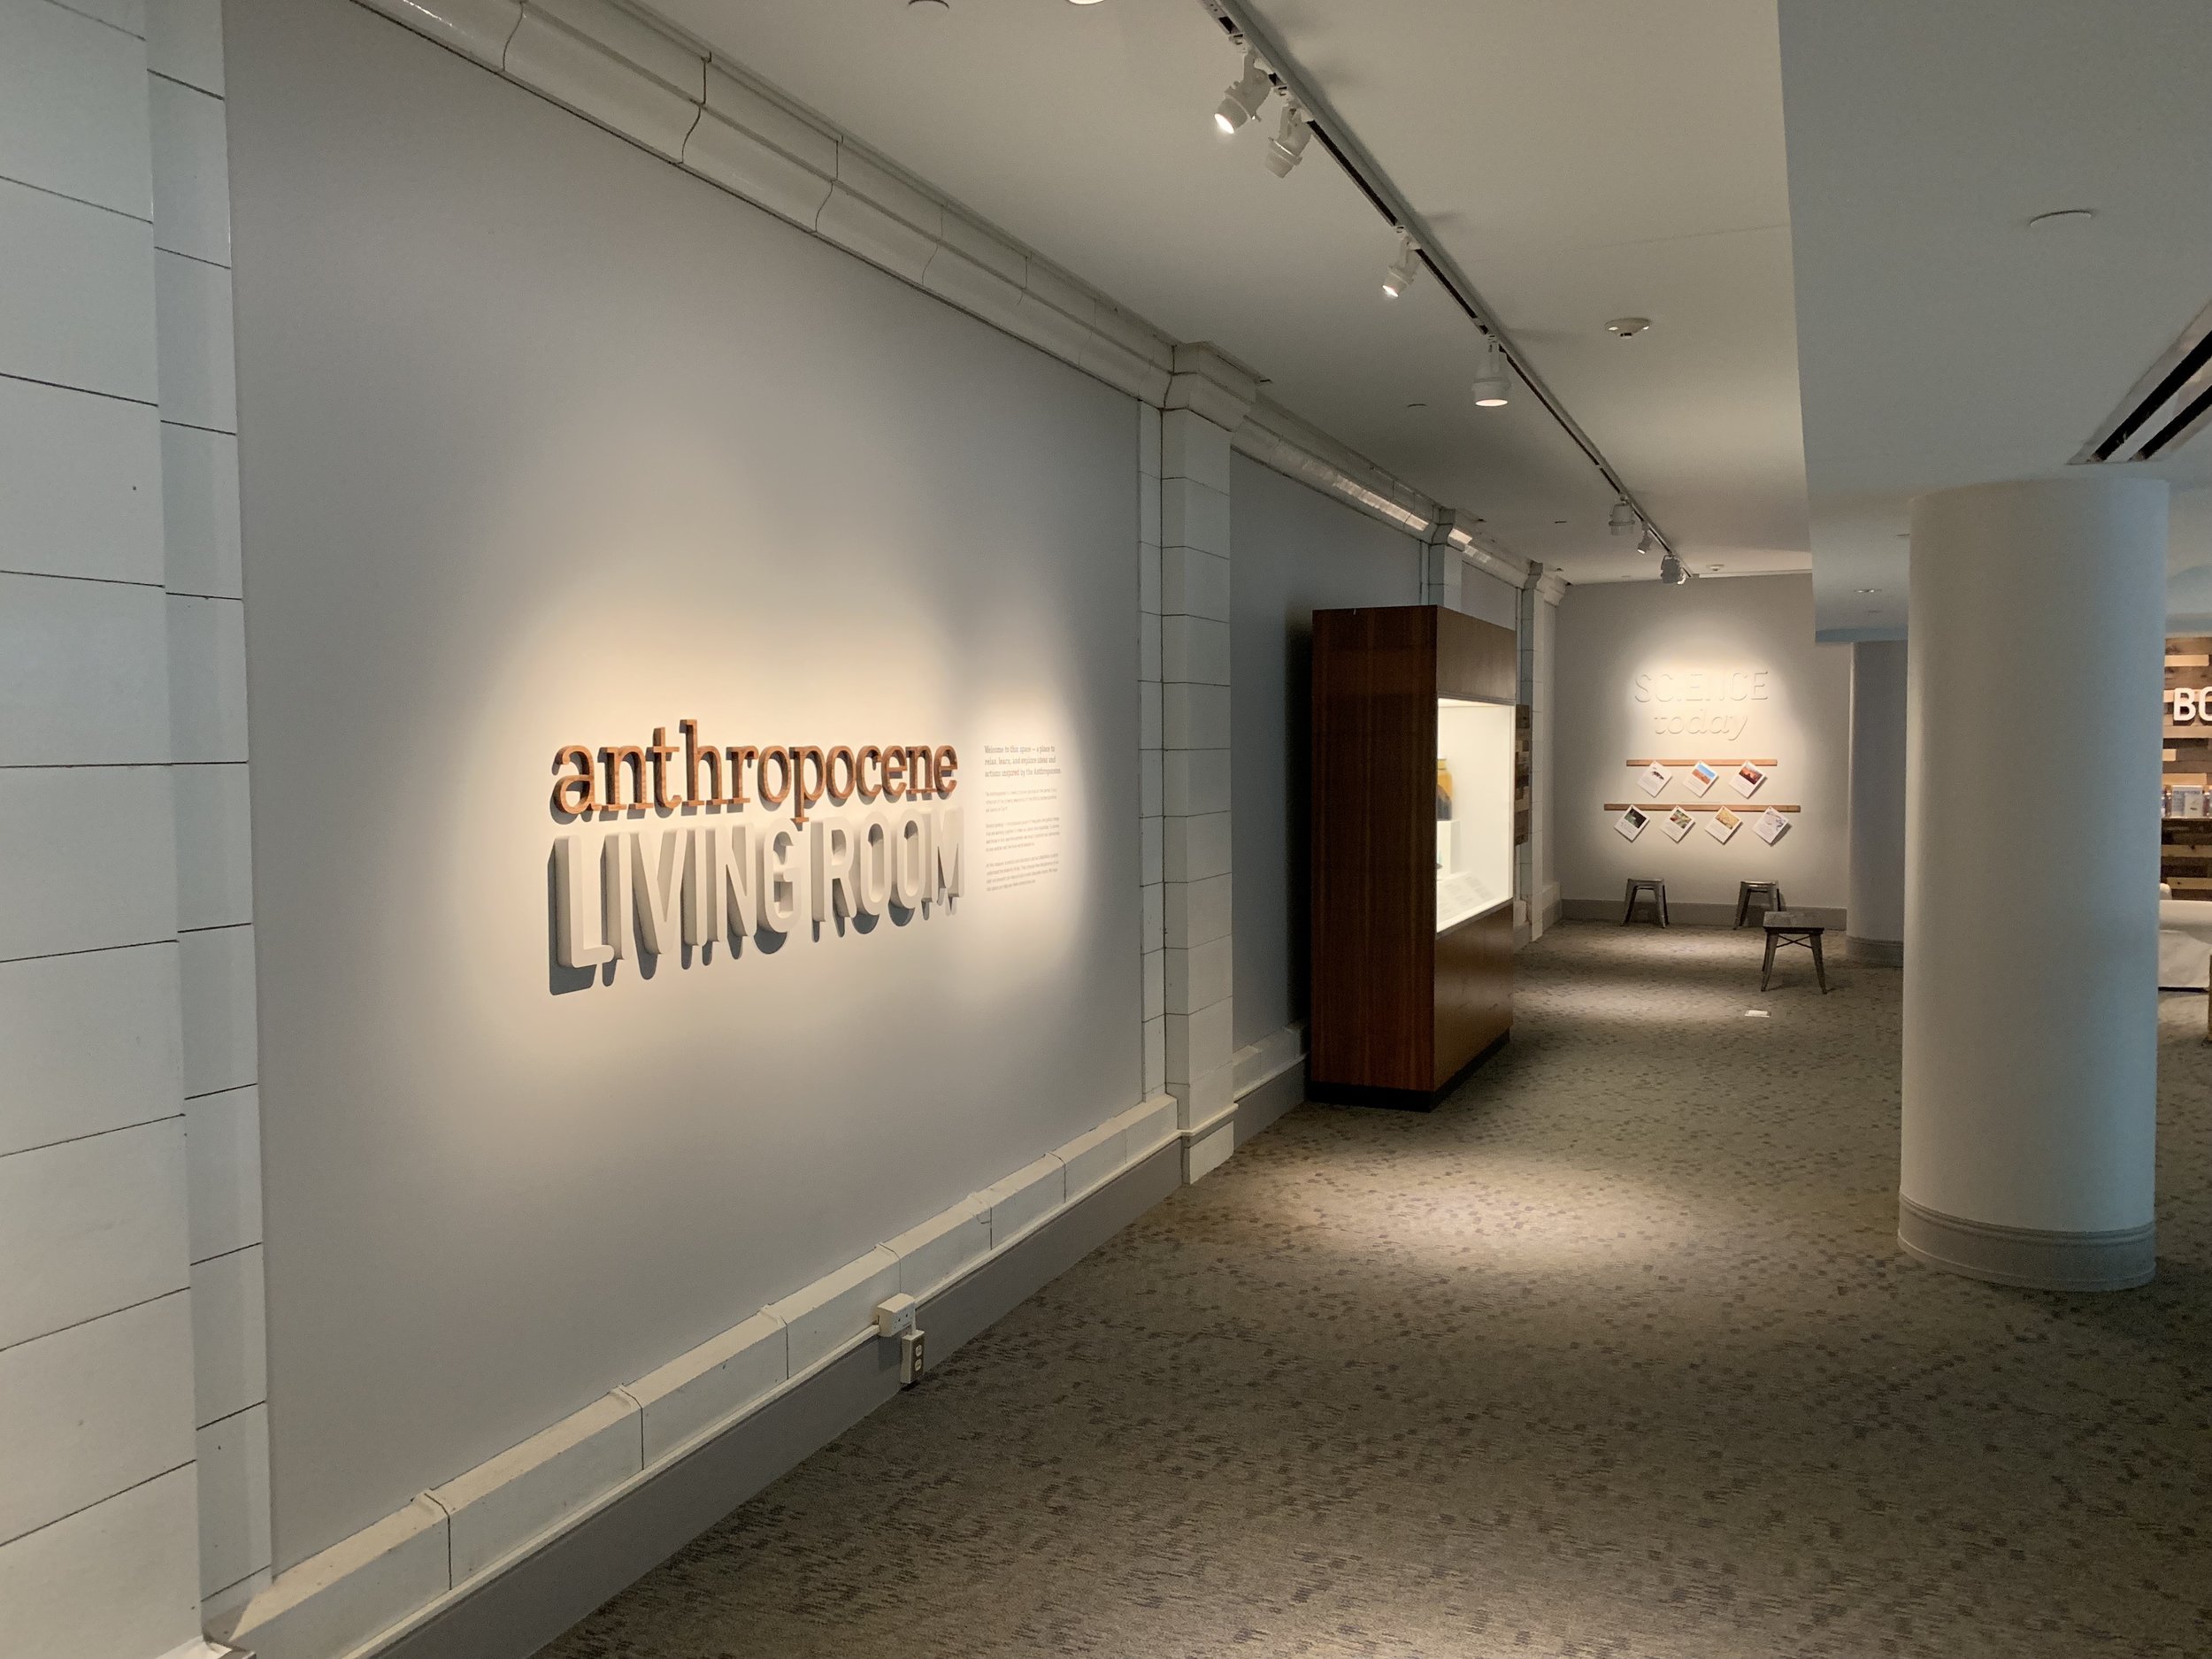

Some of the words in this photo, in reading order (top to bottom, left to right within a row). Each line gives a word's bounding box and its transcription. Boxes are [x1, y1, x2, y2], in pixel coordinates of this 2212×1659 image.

[1635, 671, 1769, 703] SCIENCE
[1654, 709, 1748, 741] today
[1039, 745, 1050, 754] place
[552, 719, 959, 826] anthropocene
[1001, 769, 1019, 778] inspired
[556, 815, 801, 969] LIVING
[810, 805, 966, 923] ROOM
